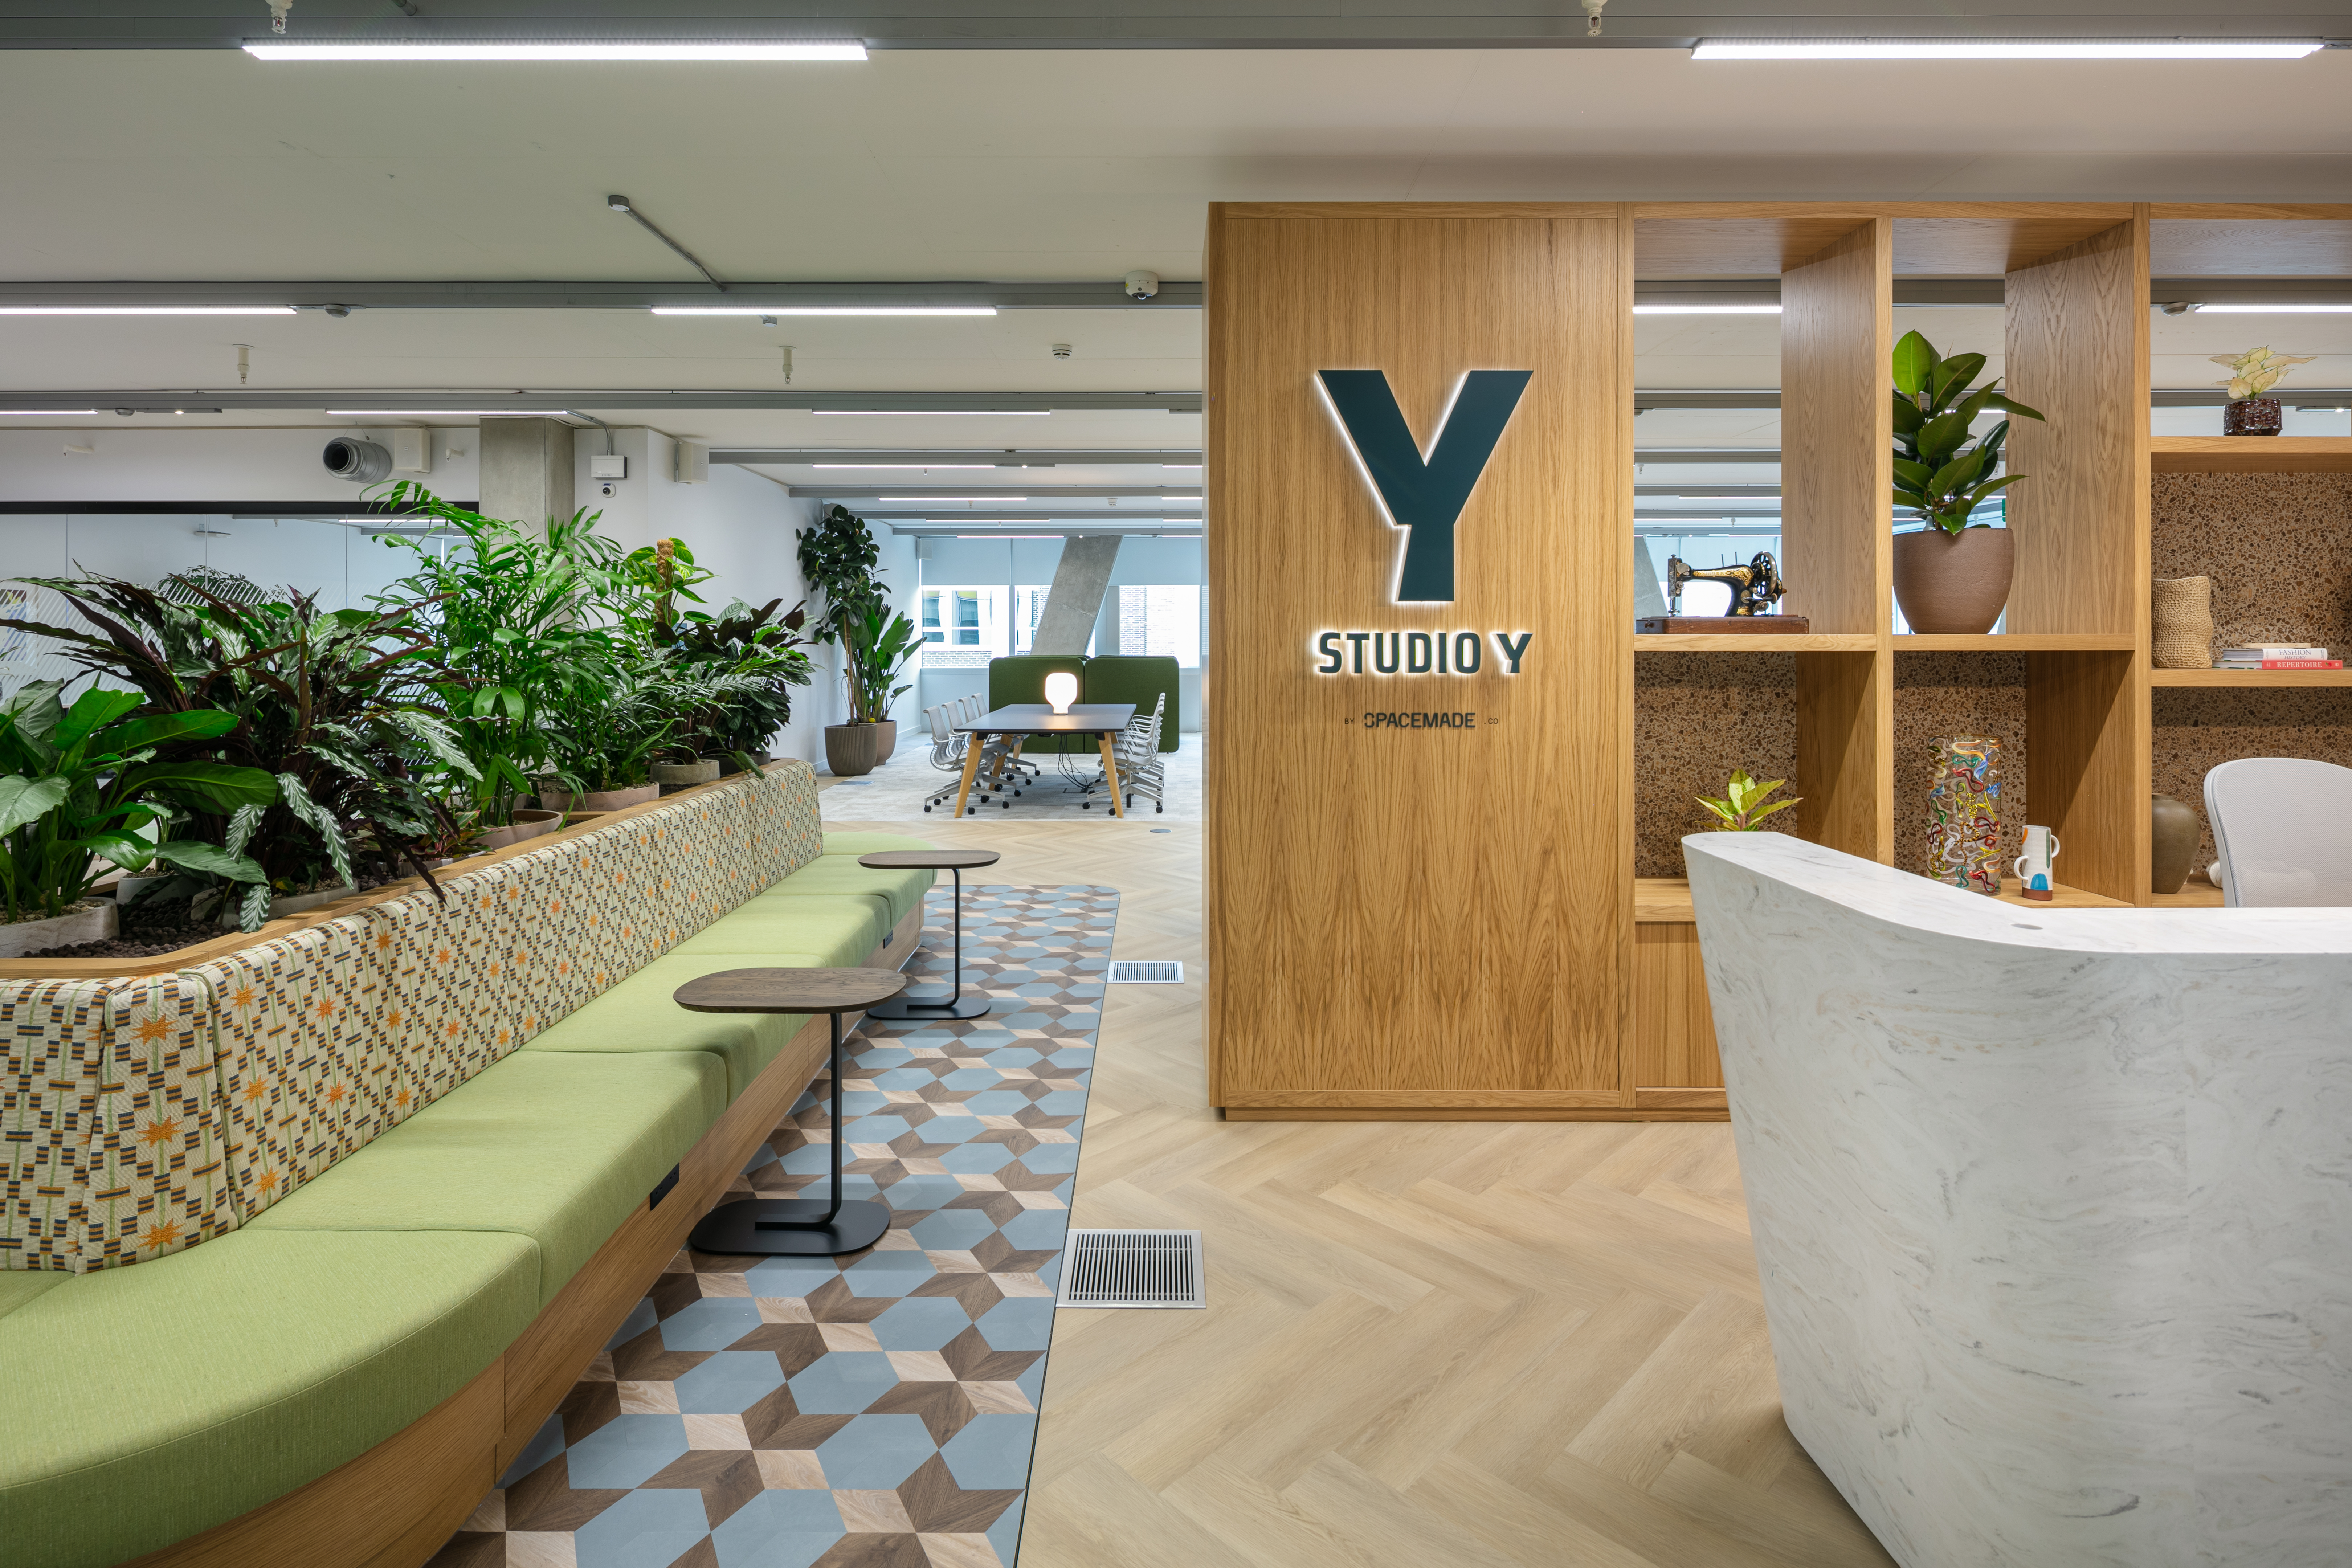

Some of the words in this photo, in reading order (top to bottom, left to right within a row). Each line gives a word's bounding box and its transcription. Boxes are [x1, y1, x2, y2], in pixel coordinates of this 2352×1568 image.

[1315, 369, 1534, 601] Y
[1318, 632, 1481, 674] STUDIO
[1491, 633, 1534, 673] Y
[1364, 712, 1476, 728] SPACEMADE
